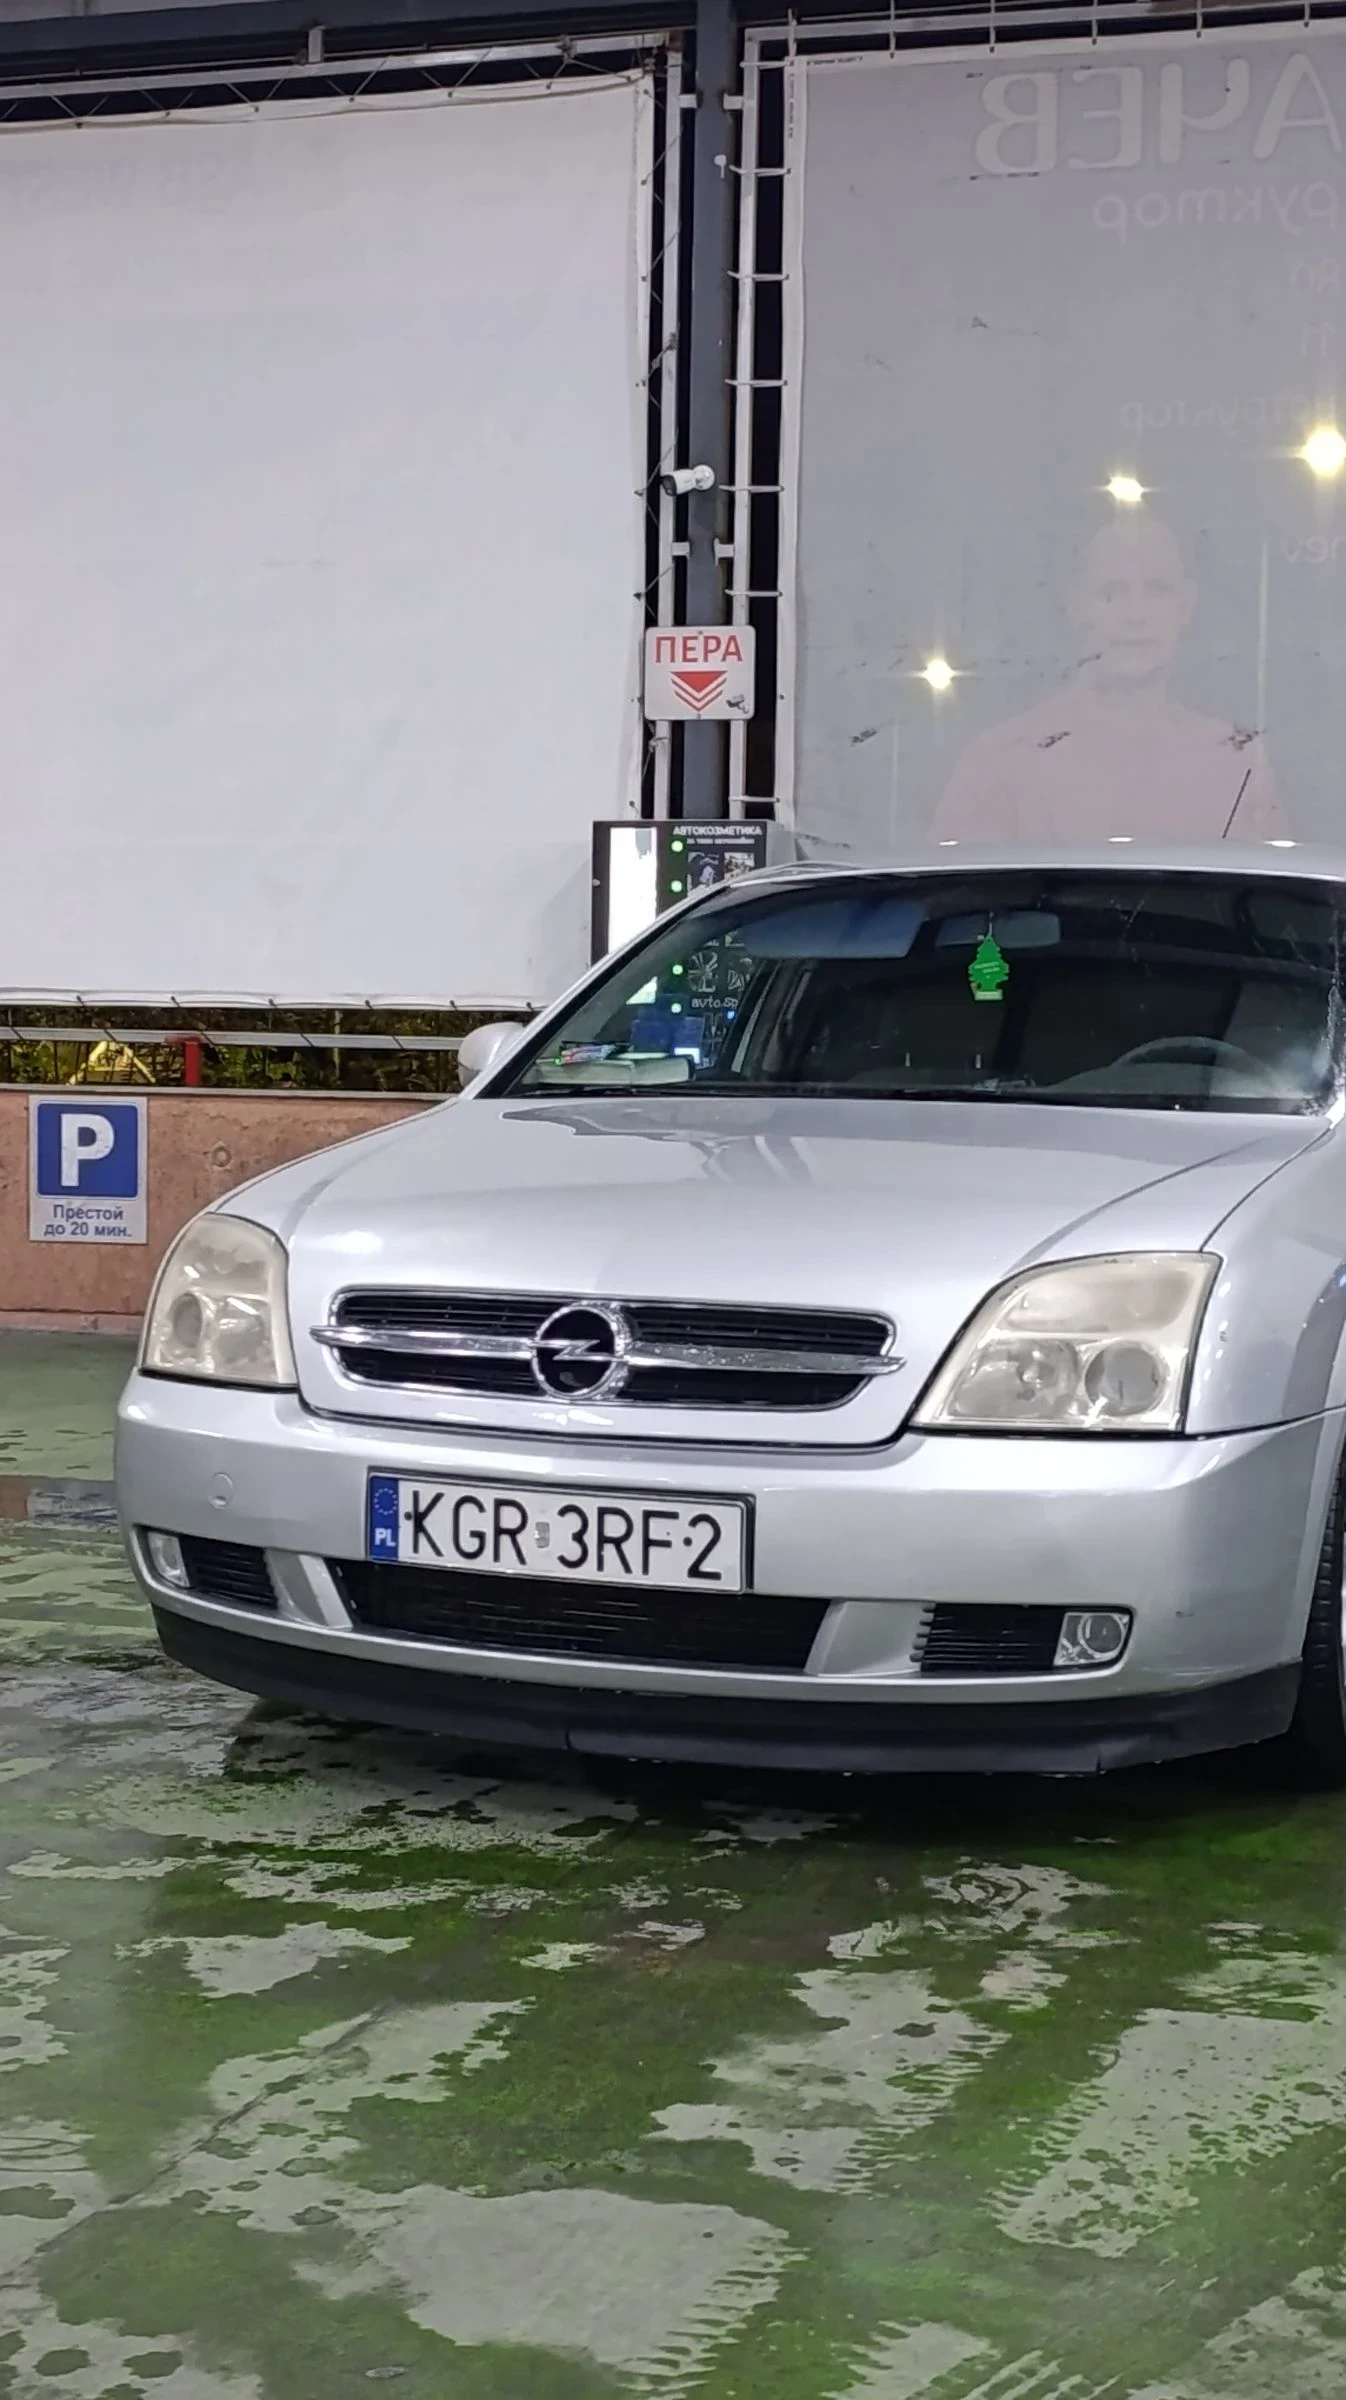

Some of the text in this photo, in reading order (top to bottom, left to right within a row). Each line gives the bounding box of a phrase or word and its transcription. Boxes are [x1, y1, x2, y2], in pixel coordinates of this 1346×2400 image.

[655, 634, 743, 663] ПЕРА
[672, 825, 763, 836] АВТОКОЗМЕТИКА
[61, 1113, 115, 1187] P
[53, 1204, 124, 1222] Престой
[43, 1221, 132, 1238] до 20 мин.
[374, 1527, 396, 1547] PL
[412, 1489, 723, 1581] KGR 3RF2
